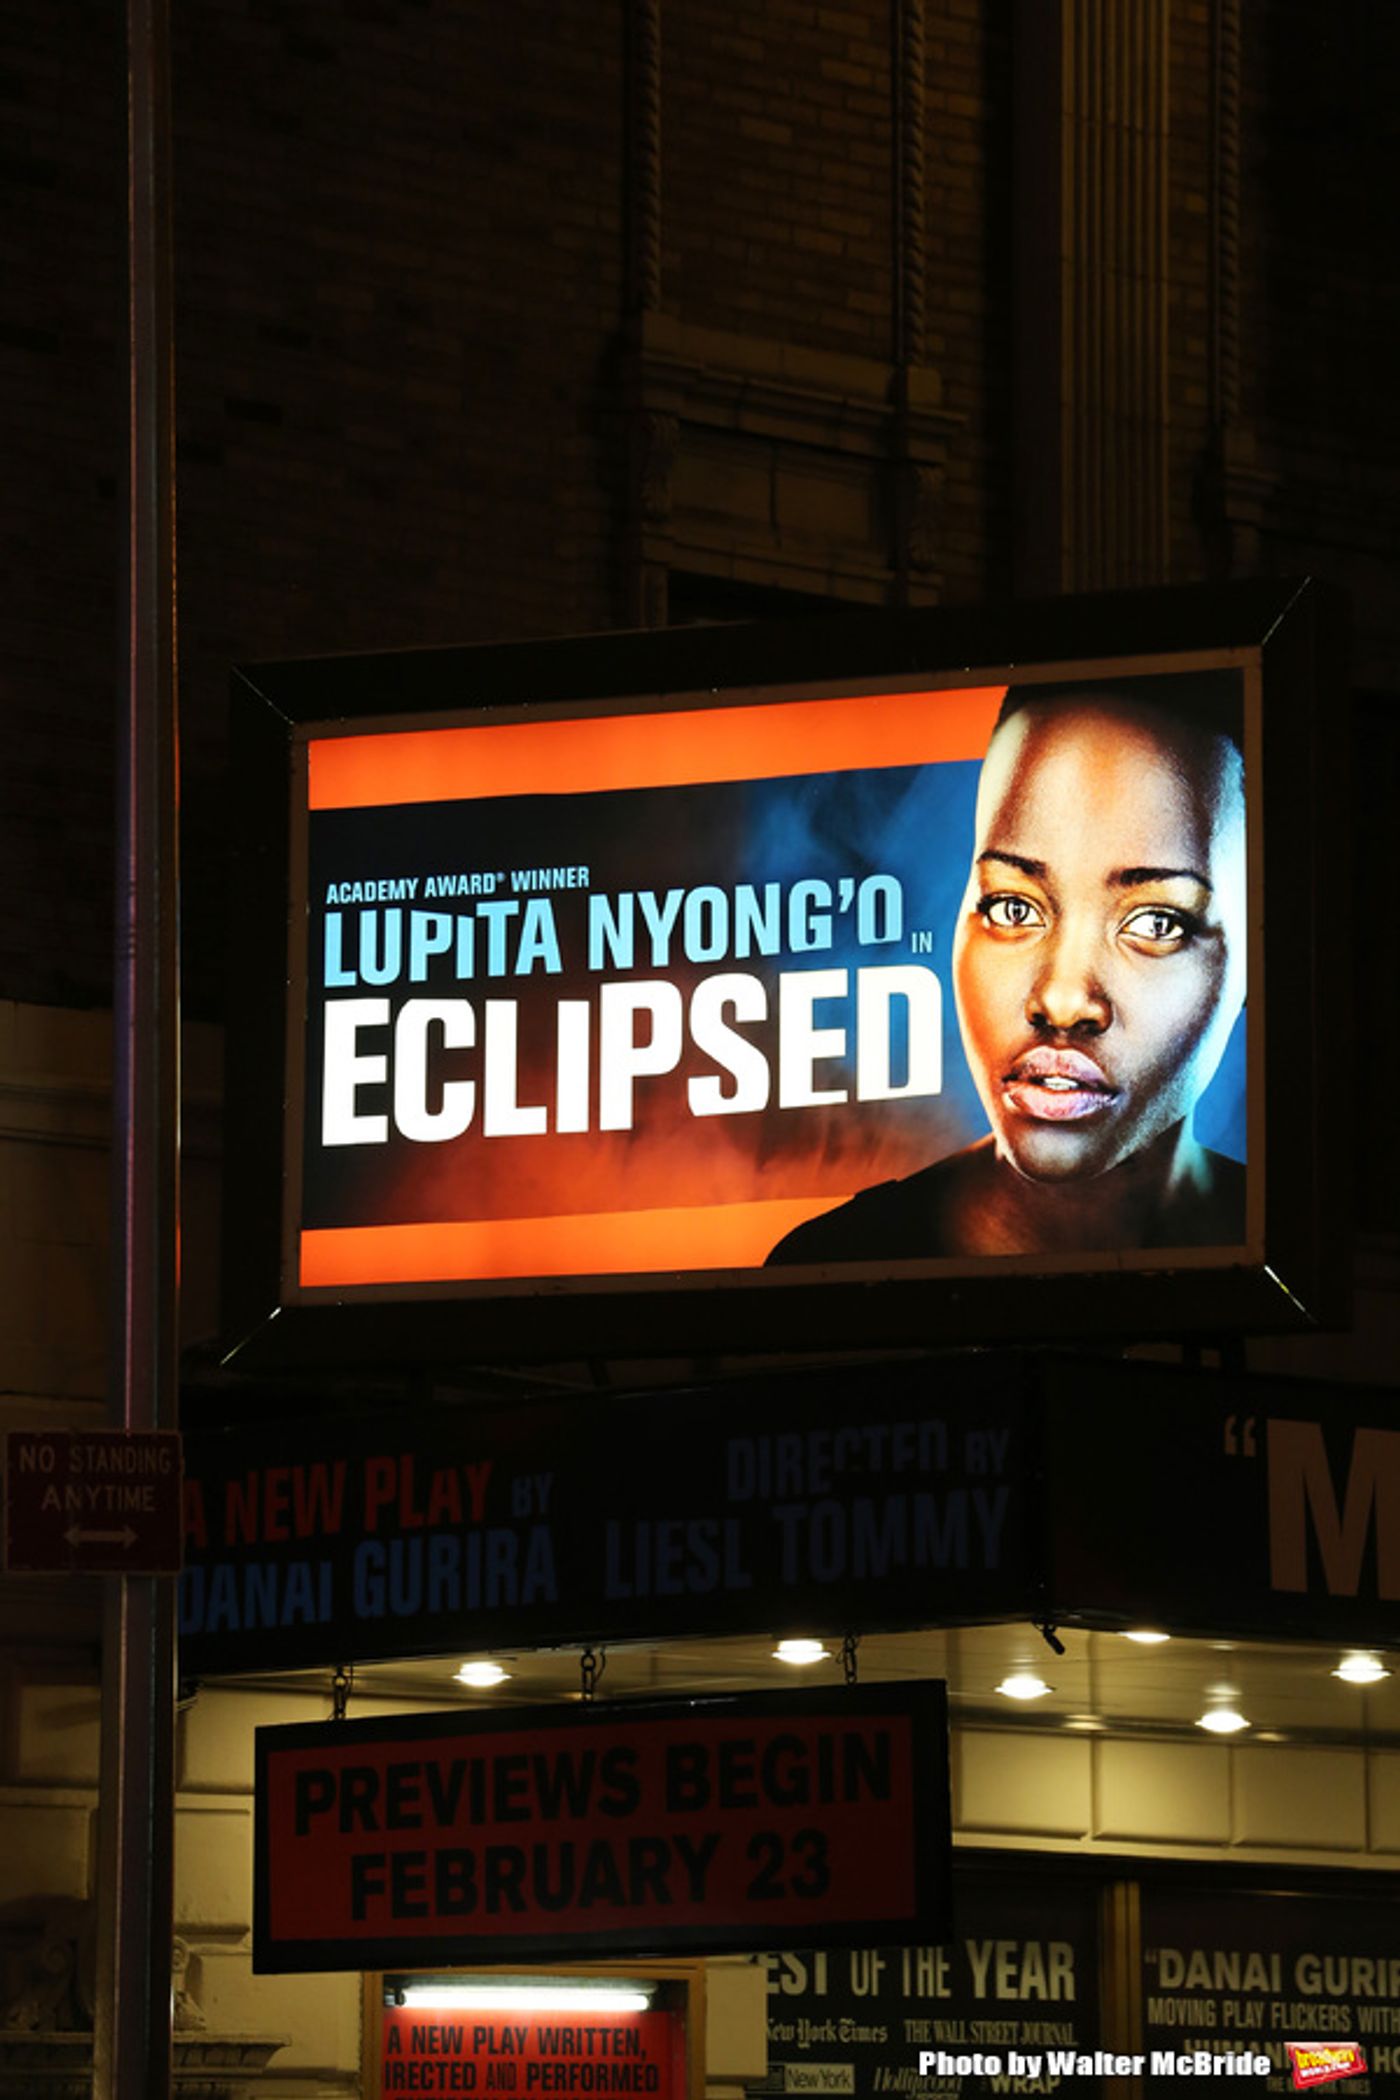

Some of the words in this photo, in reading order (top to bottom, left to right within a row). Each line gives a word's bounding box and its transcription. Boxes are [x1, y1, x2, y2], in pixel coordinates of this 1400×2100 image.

[326, 877, 419, 904] ACADEMY
[511, 865, 590, 893] WINNER
[323, 897, 564, 989] LUPITA
[911, 930, 933, 955] IN
[321, 964, 944, 1148] ECLIPSED
[19, 1444, 56, 1473] NO
[68, 1445, 171, 1474] STANDING
[726, 1418, 949, 1502] DIRECTED
[40, 1484, 157, 1513] ANYTIME
[225, 1460, 348, 1546] NEW
[363, 1452, 495, 1532] PLAY
[511, 1472, 554, 1518] BY
[604, 1518, 753, 1600] LIESL
[769, 1487, 1010, 1587] TOMMY
[179, 1559, 334, 1637] DANAI
[352, 1525, 558, 1620] GURIRA
[295, 1747, 640, 1836] PREVIEWS
[664, 1731, 891, 1813] BEGIN
[349, 1833, 722, 1921] FEBRUARY
[746, 1830, 831, 1900] 23
[964, 1938, 1077, 2001] YEAR
[387, 2026, 402, 2055] A
[411, 2026, 463, 2055] NEW
[474, 2026, 529, 2055] PLAY
[538, 2027, 647, 2061] WRITTEN,
[1147, 1997, 1217, 2027] MOVING
[1222, 2000, 1264, 2028] PLAY
[1271, 2003, 1350, 2032] FLICKERS
[384, 2061, 477, 2091] IRECTED
[526, 2063, 659, 2092] PERFORMED
